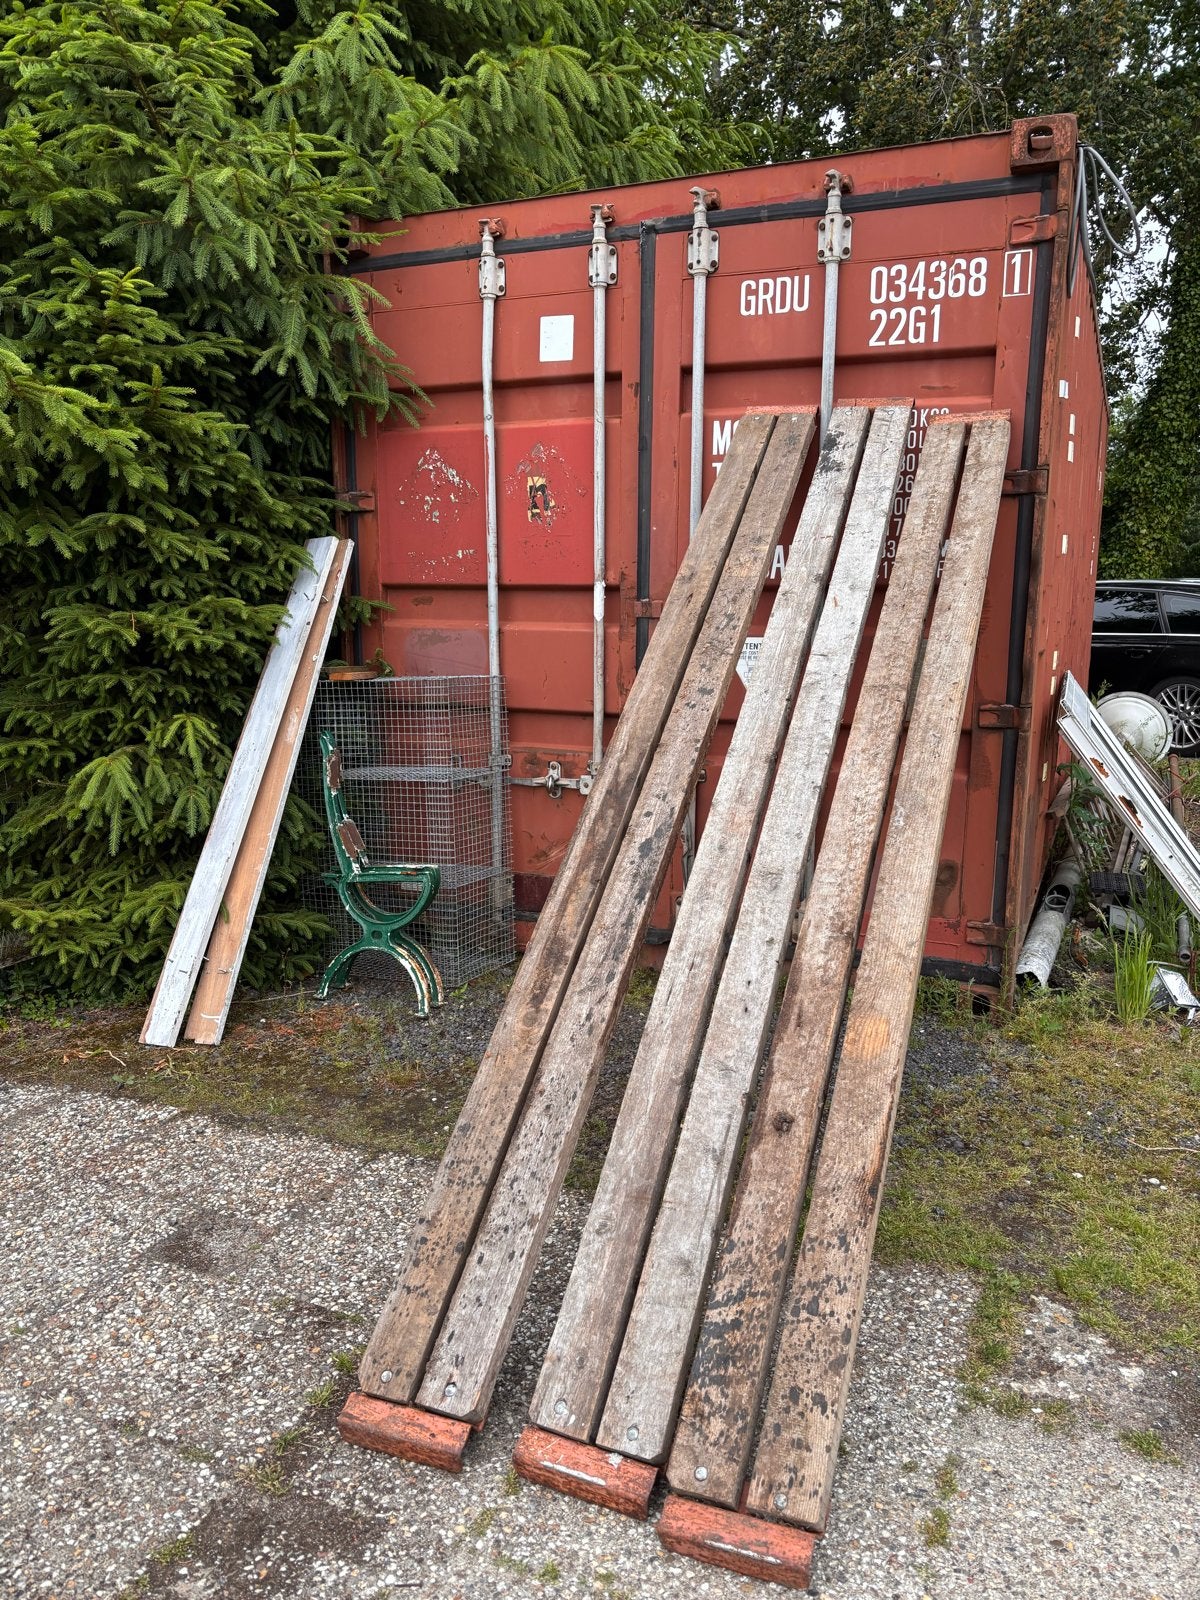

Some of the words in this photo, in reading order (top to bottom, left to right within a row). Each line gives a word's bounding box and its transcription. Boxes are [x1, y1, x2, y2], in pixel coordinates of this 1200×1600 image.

[740, 274, 810, 316] GRDU
[870, 257, 988, 304] 034368
[1010, 253, 1022, 294] 1
[868, 303, 941, 347] 22G1
